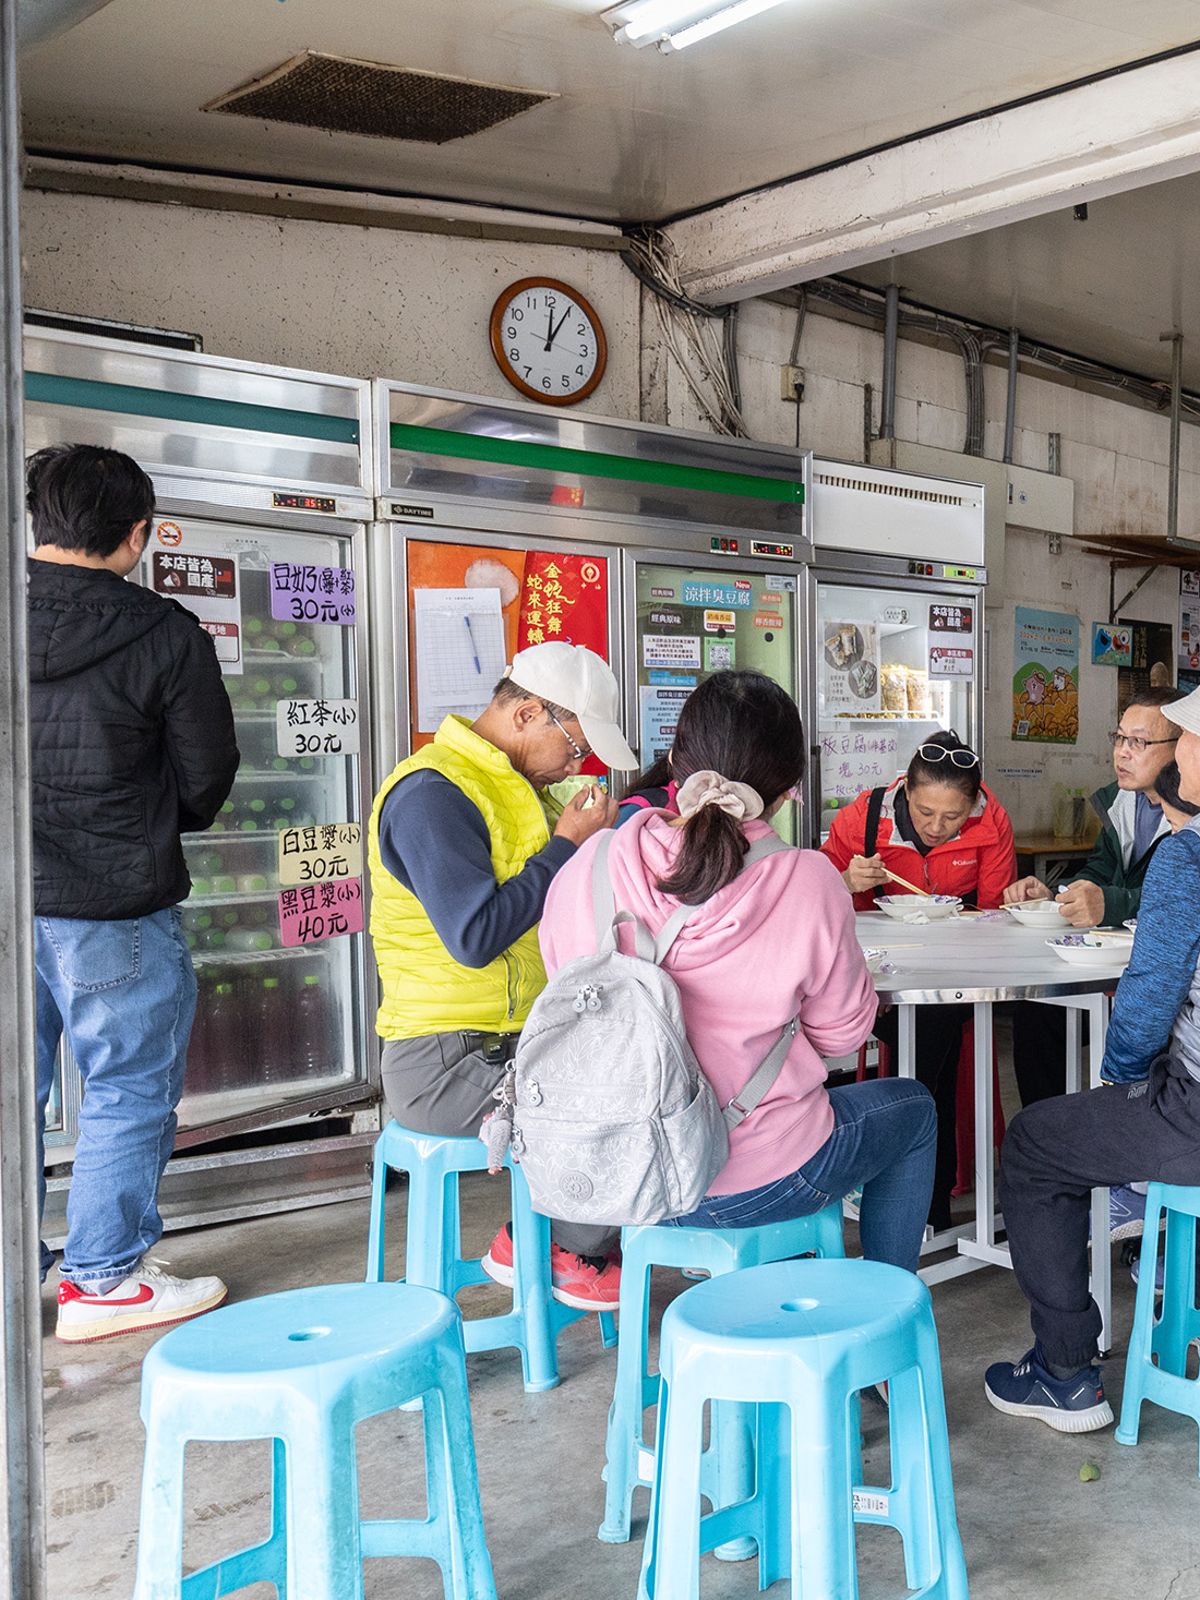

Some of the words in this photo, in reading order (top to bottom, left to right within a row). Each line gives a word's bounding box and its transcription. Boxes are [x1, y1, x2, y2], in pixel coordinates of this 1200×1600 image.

[527, 297, 537, 310] 11
[544, 296, 556, 310] 12
[511, 308, 524, 322] 10
[507, 326, 517, 339] 9
[577, 324, 586, 336] 2
[510, 348, 520, 361] 8
[579, 345, 588, 358] 3
[523, 366, 532, 378] 7
[575, 365, 584, 376] 4
[542, 376, 552, 389] 6
[561, 375, 570, 387] 5
[159, 554, 214, 572] 本店皆為
[187, 573, 215, 589] 國產
[735, 581, 751, 589] New
[685, 586, 750, 606] 涼拌臭豆腐
[526, 574, 546, 644] 蛇來運轉
[932, 607, 962, 617] 本店皆為
[287, 700, 356, 727] 紅茶(小)
[296, 734, 342, 753] 30元
[283, 824, 360, 855] 白豆漿(小)
[300, 855, 348, 880] 30元
[281, 882, 360, 919] 黑豆漿(小)
[298, 912, 348, 942] 40元
